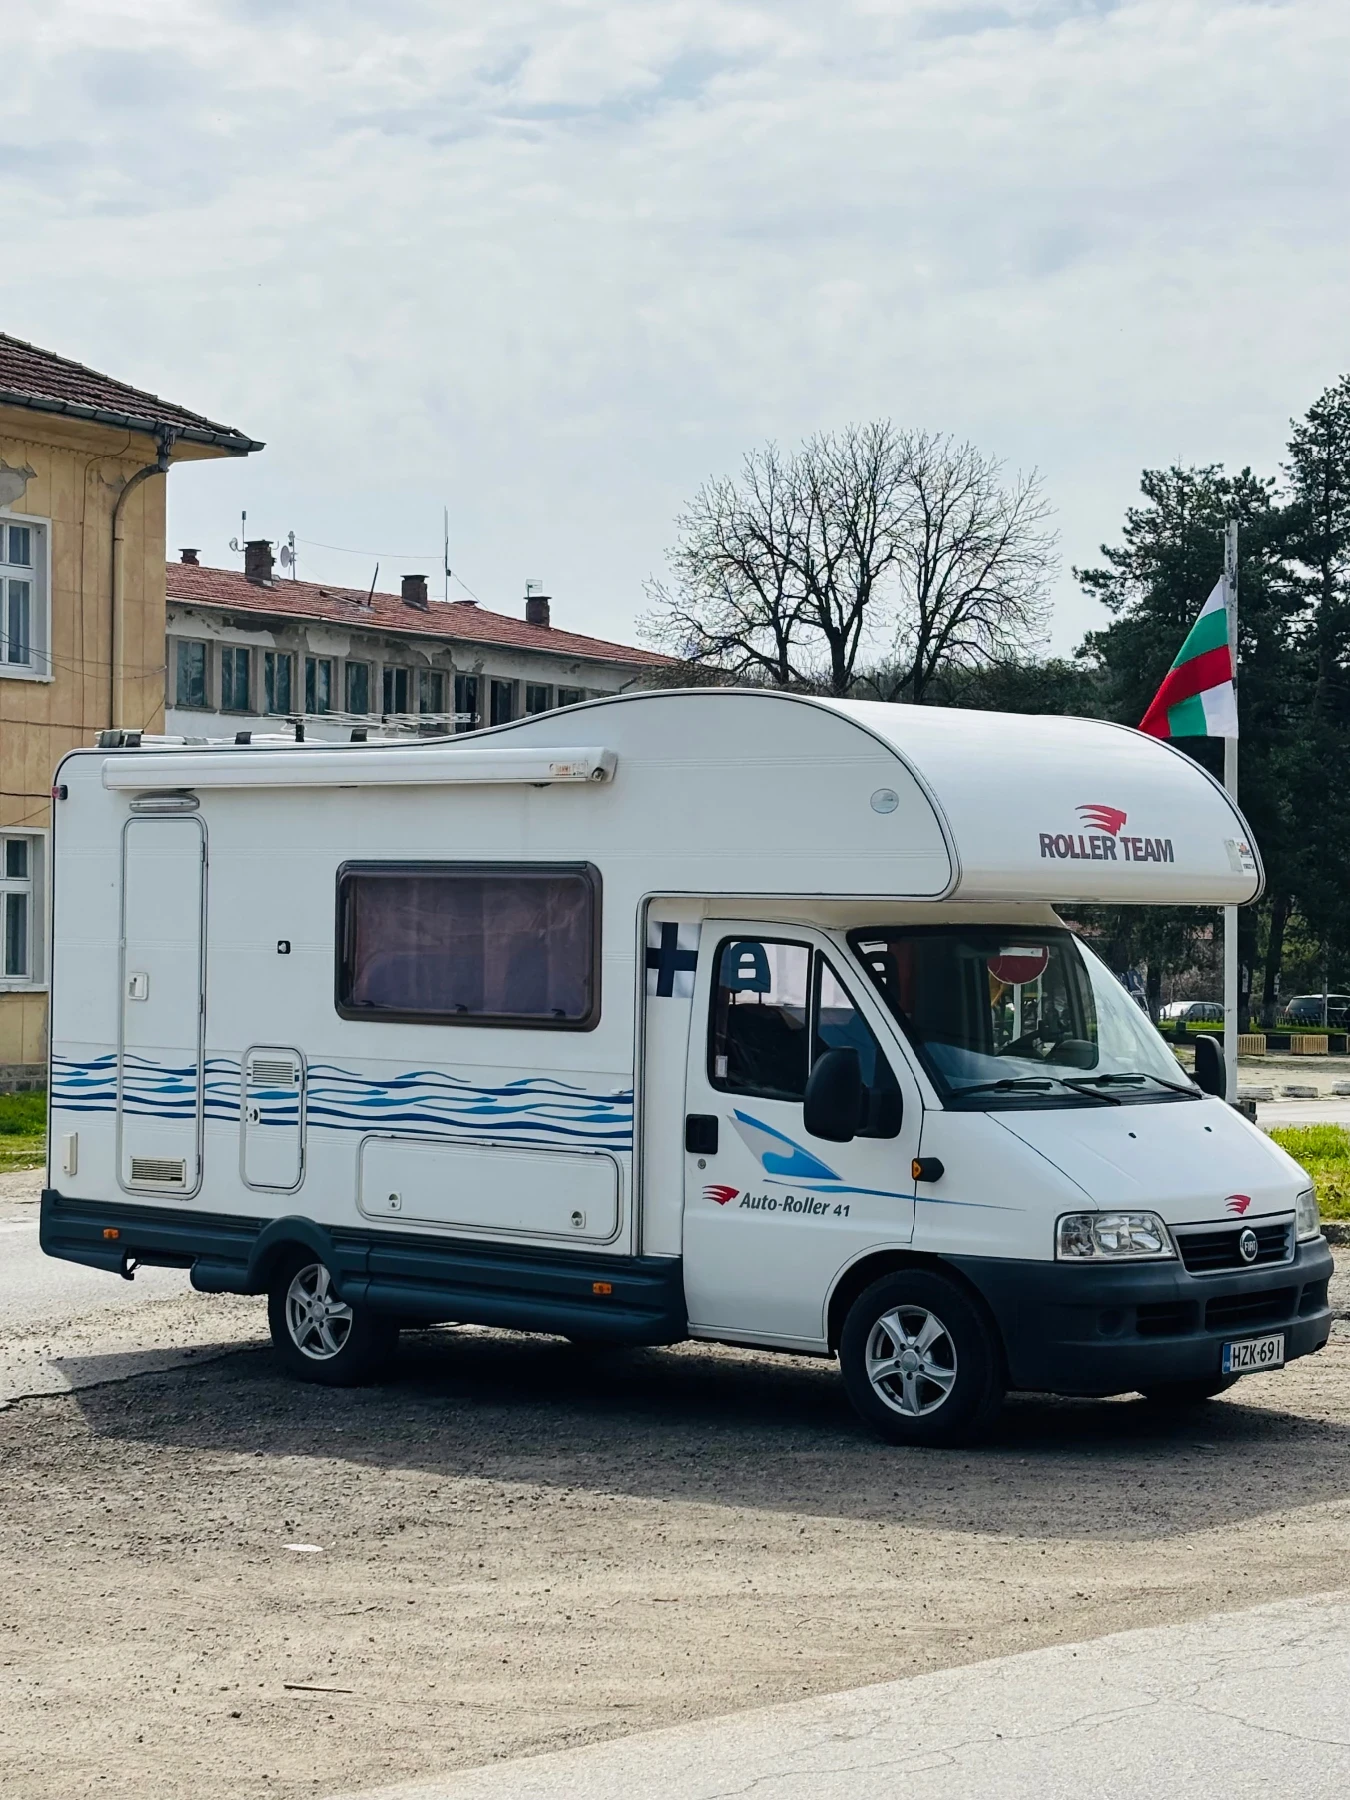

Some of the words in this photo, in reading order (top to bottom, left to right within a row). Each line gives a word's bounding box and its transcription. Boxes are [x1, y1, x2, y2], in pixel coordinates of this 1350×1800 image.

[1039, 833, 1117, 860] ROLLER
[1119, 836, 1174, 862] TEAM
[739, 1192, 830, 1215] Auto-Roller
[833, 1204, 850, 1217] 41
[1244, 1240, 1256, 1251] FIAT
